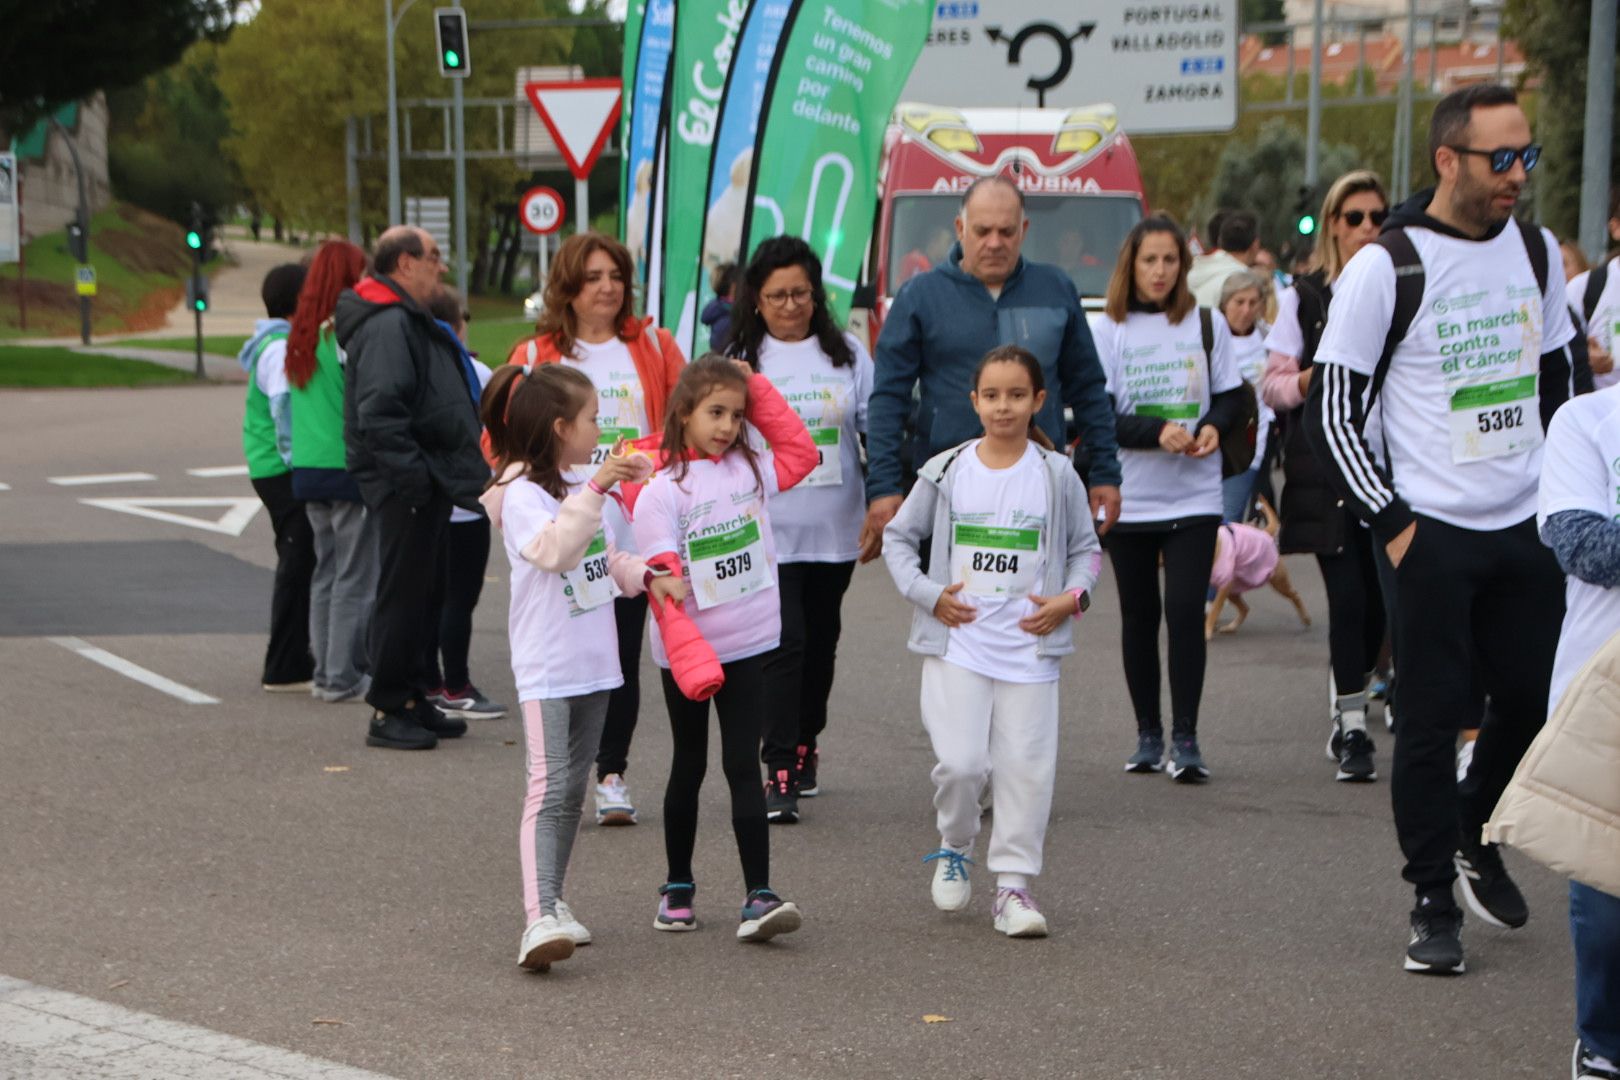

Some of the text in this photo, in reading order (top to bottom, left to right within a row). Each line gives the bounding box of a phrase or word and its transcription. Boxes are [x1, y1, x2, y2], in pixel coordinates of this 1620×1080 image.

[1123, 4, 1223, 26] PORTUGAL
[823, 4, 893, 60] Tenemos
[1112, 30, 1225, 53] VALLADOLID
[812, 32, 872, 75] un gran
[805, 54, 864, 93] camino
[797, 77, 830, 100] por
[1145, 83, 1223, 103] ZAMORA
[792, 97, 861, 136] delante
[531, 203, 554, 219] 30
[1437, 309, 1529, 340] En marcha
[1439, 333, 1501, 357] contra
[1125, 357, 1194, 376] En marcha
[1441, 347, 1523, 374] el cáncer
[1127, 373, 1170, 388] contra
[600, 386, 628, 400] cha
[1478, 405, 1524, 434] 5382
[702, 513, 753, 537] marcha
[584, 554, 609, 583] 538
[715, 551, 752, 581] 5379
[972, 551, 1019, 574] 8264
